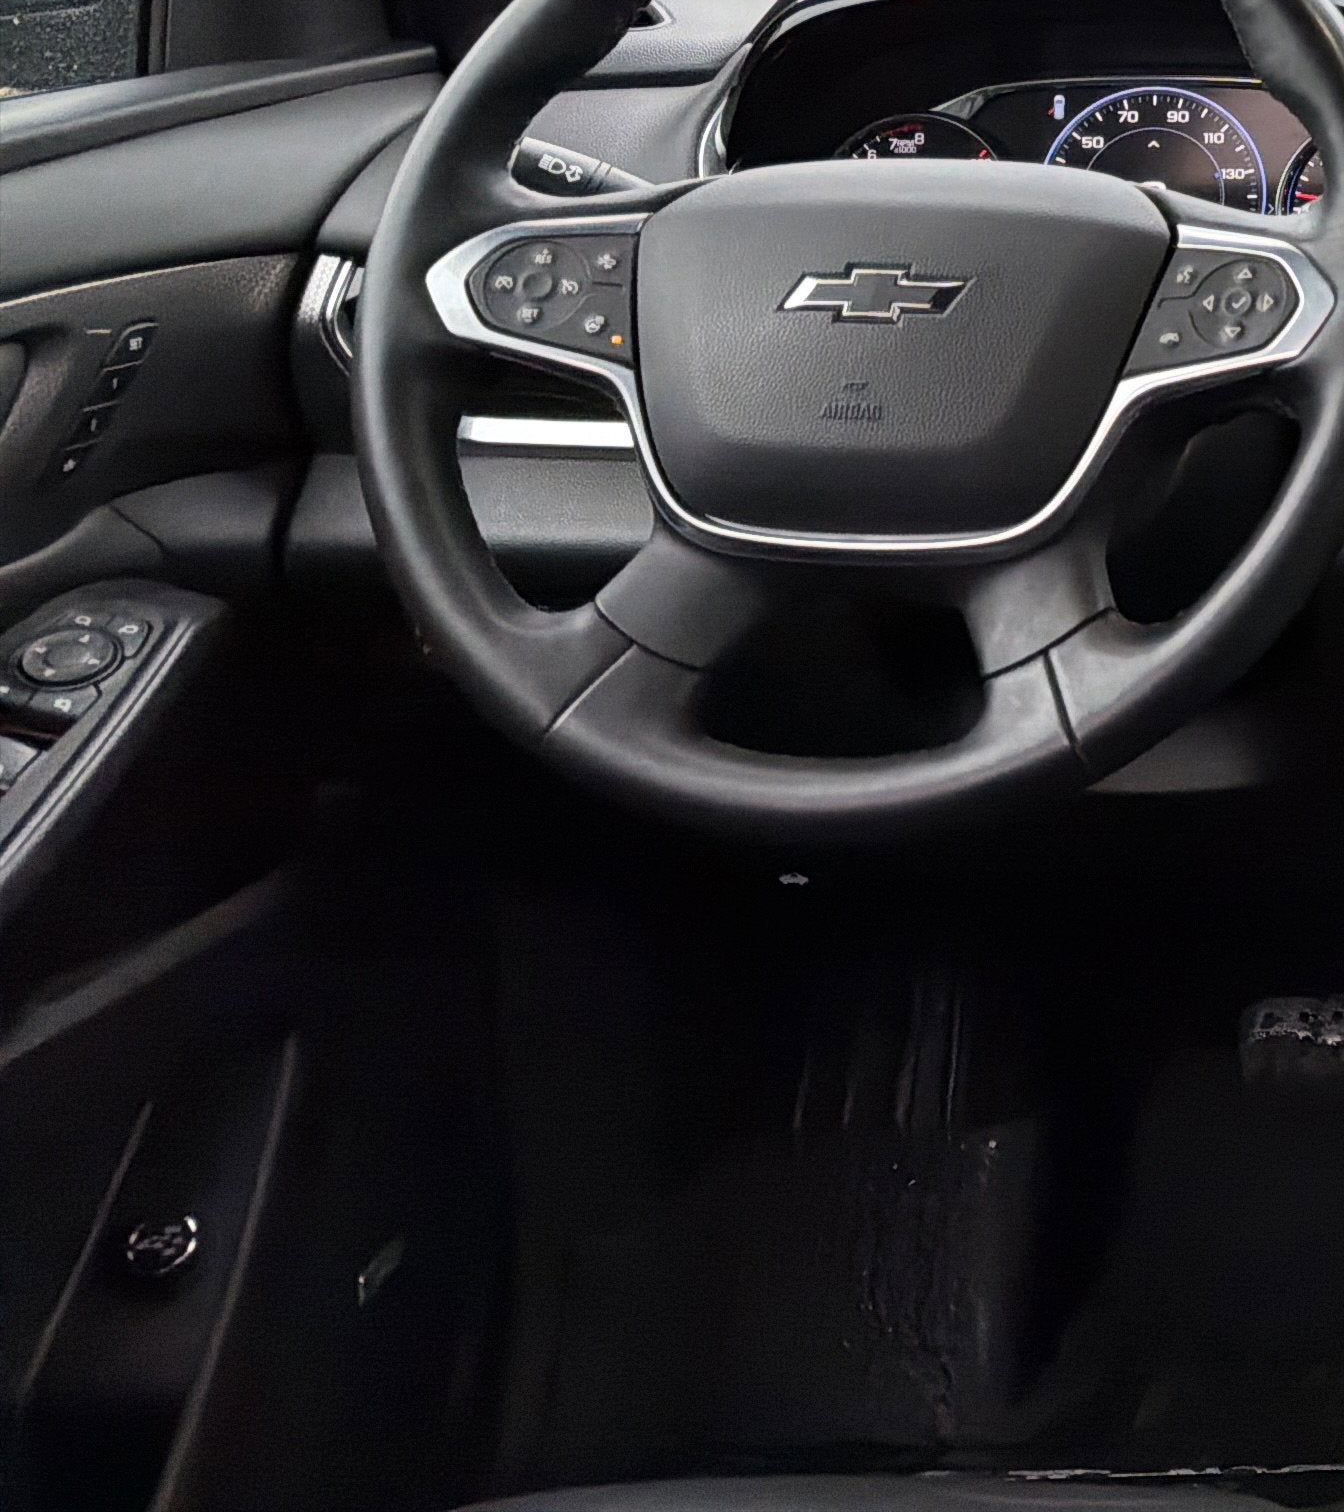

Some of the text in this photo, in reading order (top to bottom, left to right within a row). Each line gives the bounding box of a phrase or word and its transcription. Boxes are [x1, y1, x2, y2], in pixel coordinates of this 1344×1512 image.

[1117, 110, 1140, 124] 70
[1166, 110, 1190, 124] 90
[1081, 136, 1105, 149] 50
[1203, 132, 1226, 145] 110
[1221, 168, 1246, 180] 130
